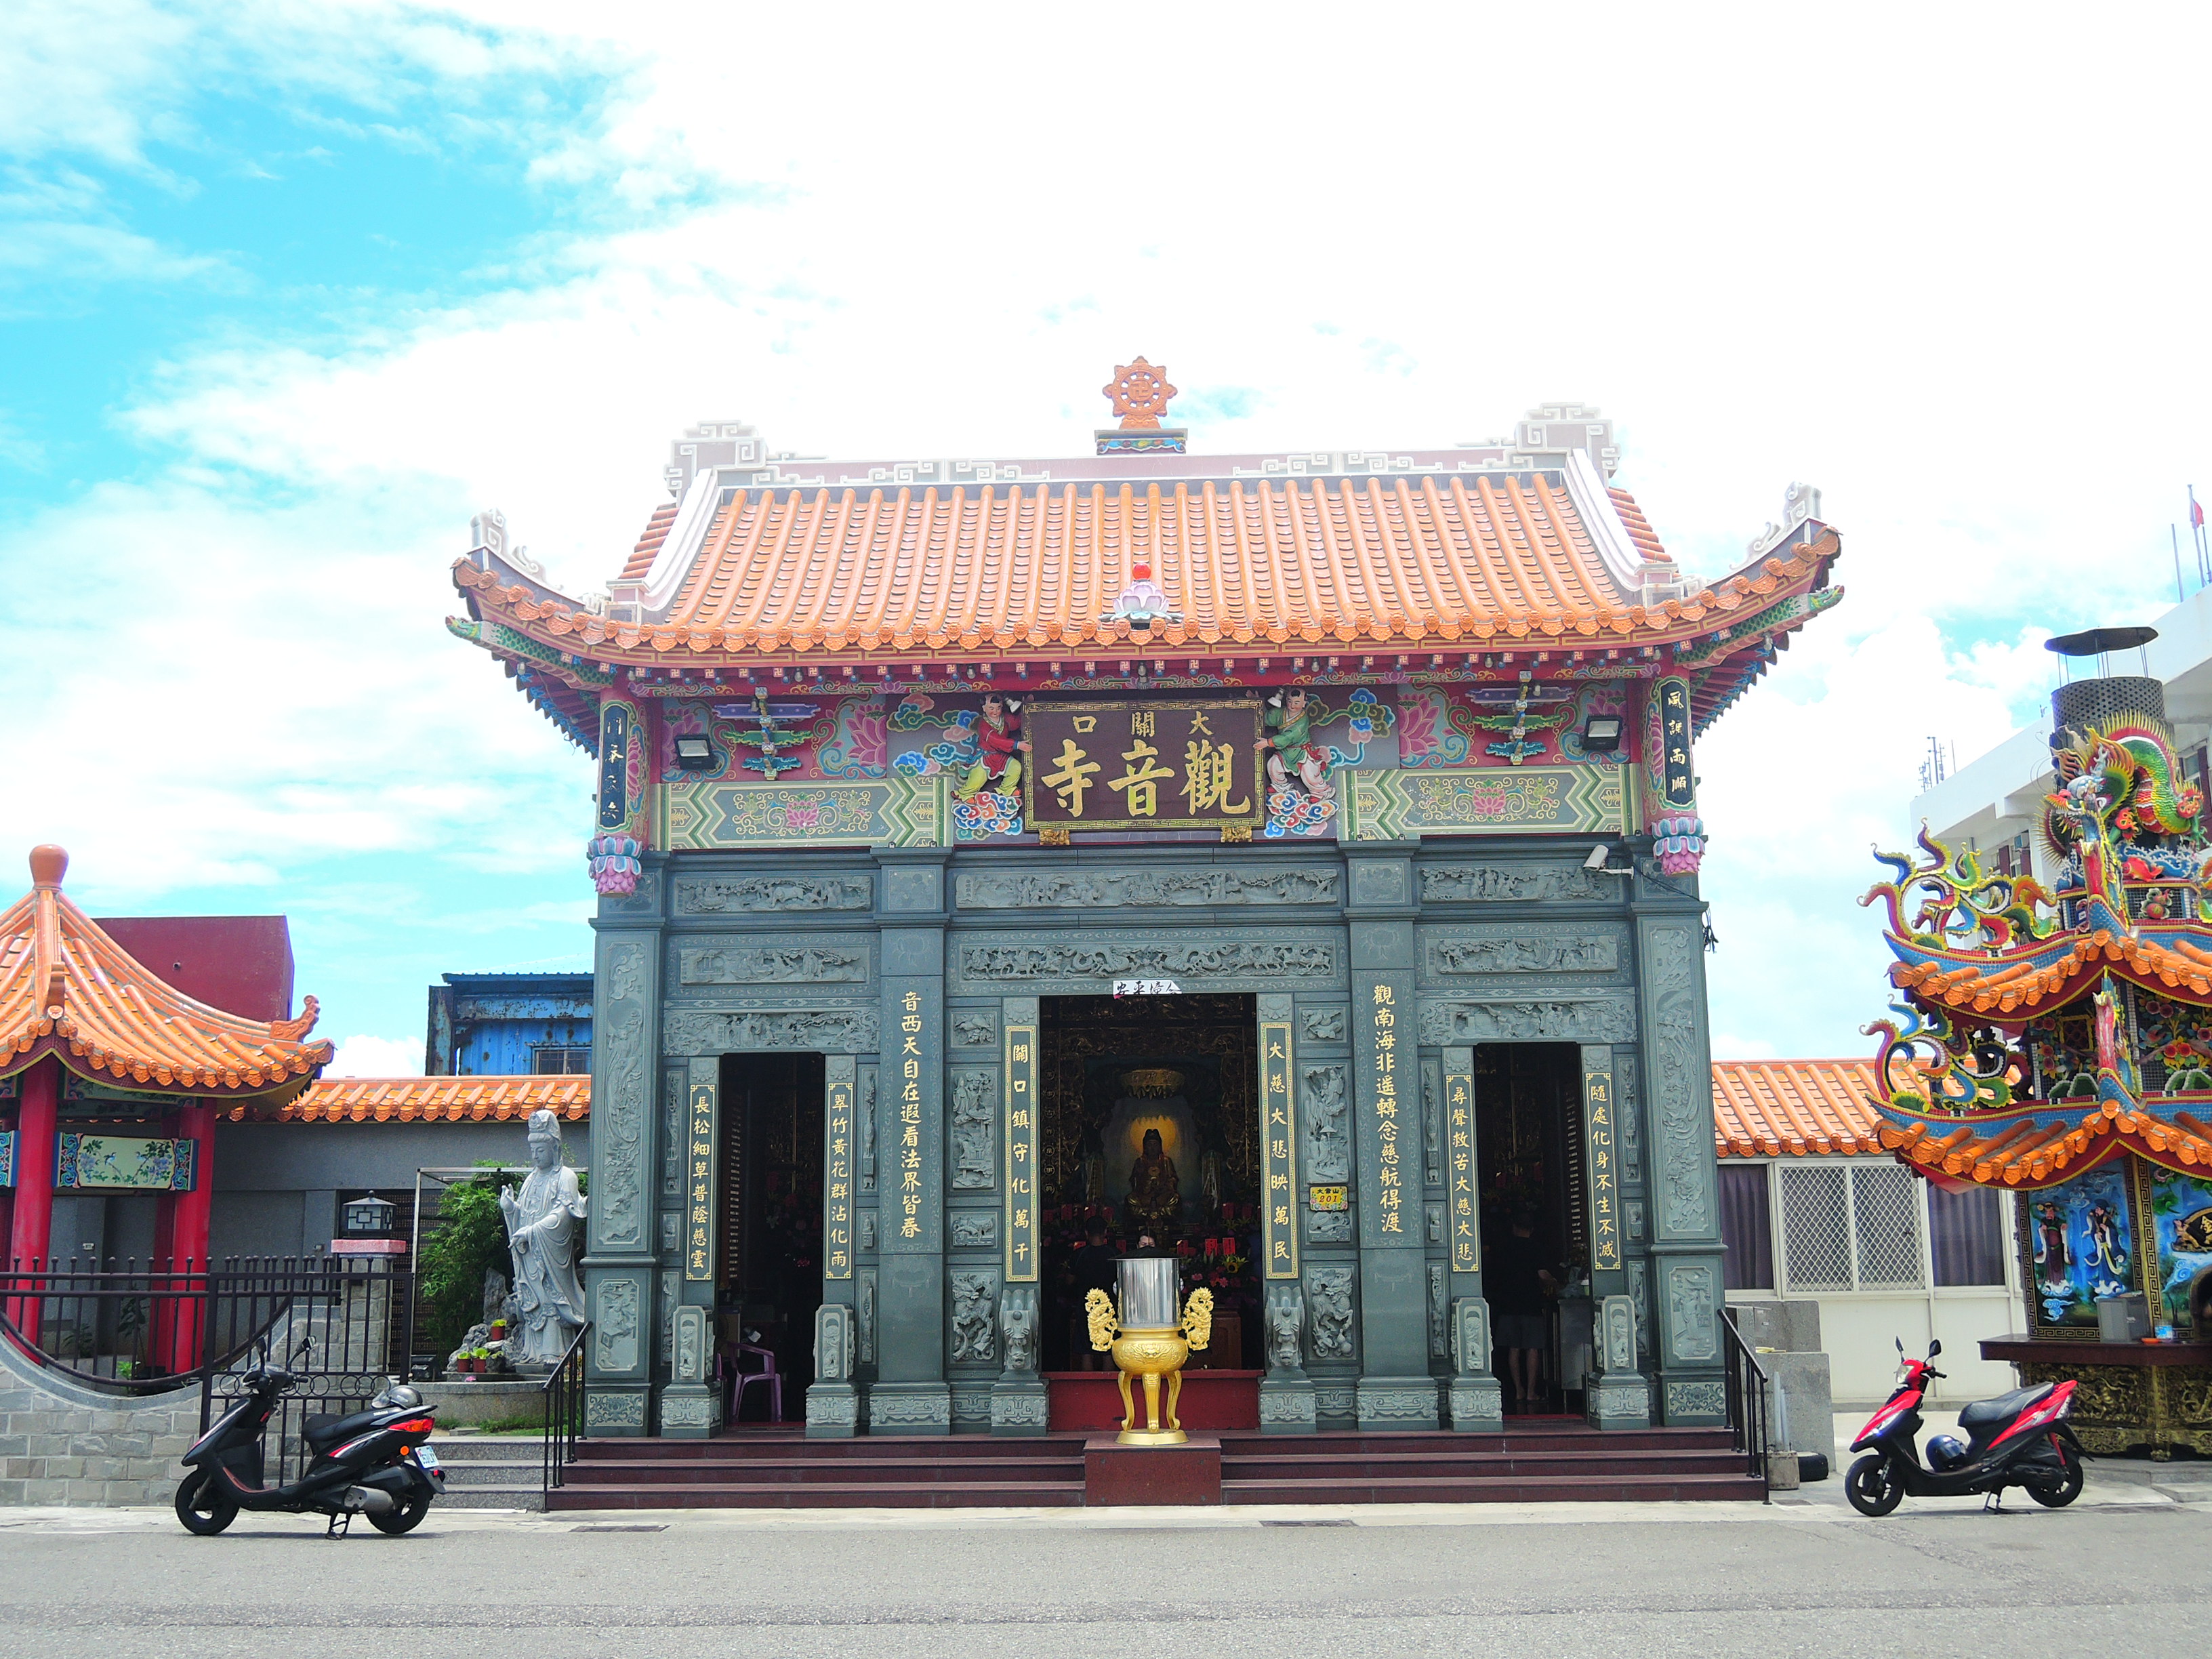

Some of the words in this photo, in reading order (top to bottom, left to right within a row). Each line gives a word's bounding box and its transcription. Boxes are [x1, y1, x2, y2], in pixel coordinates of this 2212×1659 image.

[1041, 739, 1252, 817] 觀音寺
[1072, 710, 1214, 737] 大關口
[691, 1096, 710, 1269] 長松細草普蔭慈雲
[900, 991, 922, 1239] 音西天自在遐看法界皆春
[1012, 1044, 1030, 1263] 關口鎮守化萬千
[1268, 1041, 1290, 1260] 大慈大悲映萬民
[1452, 1087, 1473, 1261] 尋聲救苦大慈大悲
[1591, 1085, 1616, 1258] 隨處化身不生不滅
